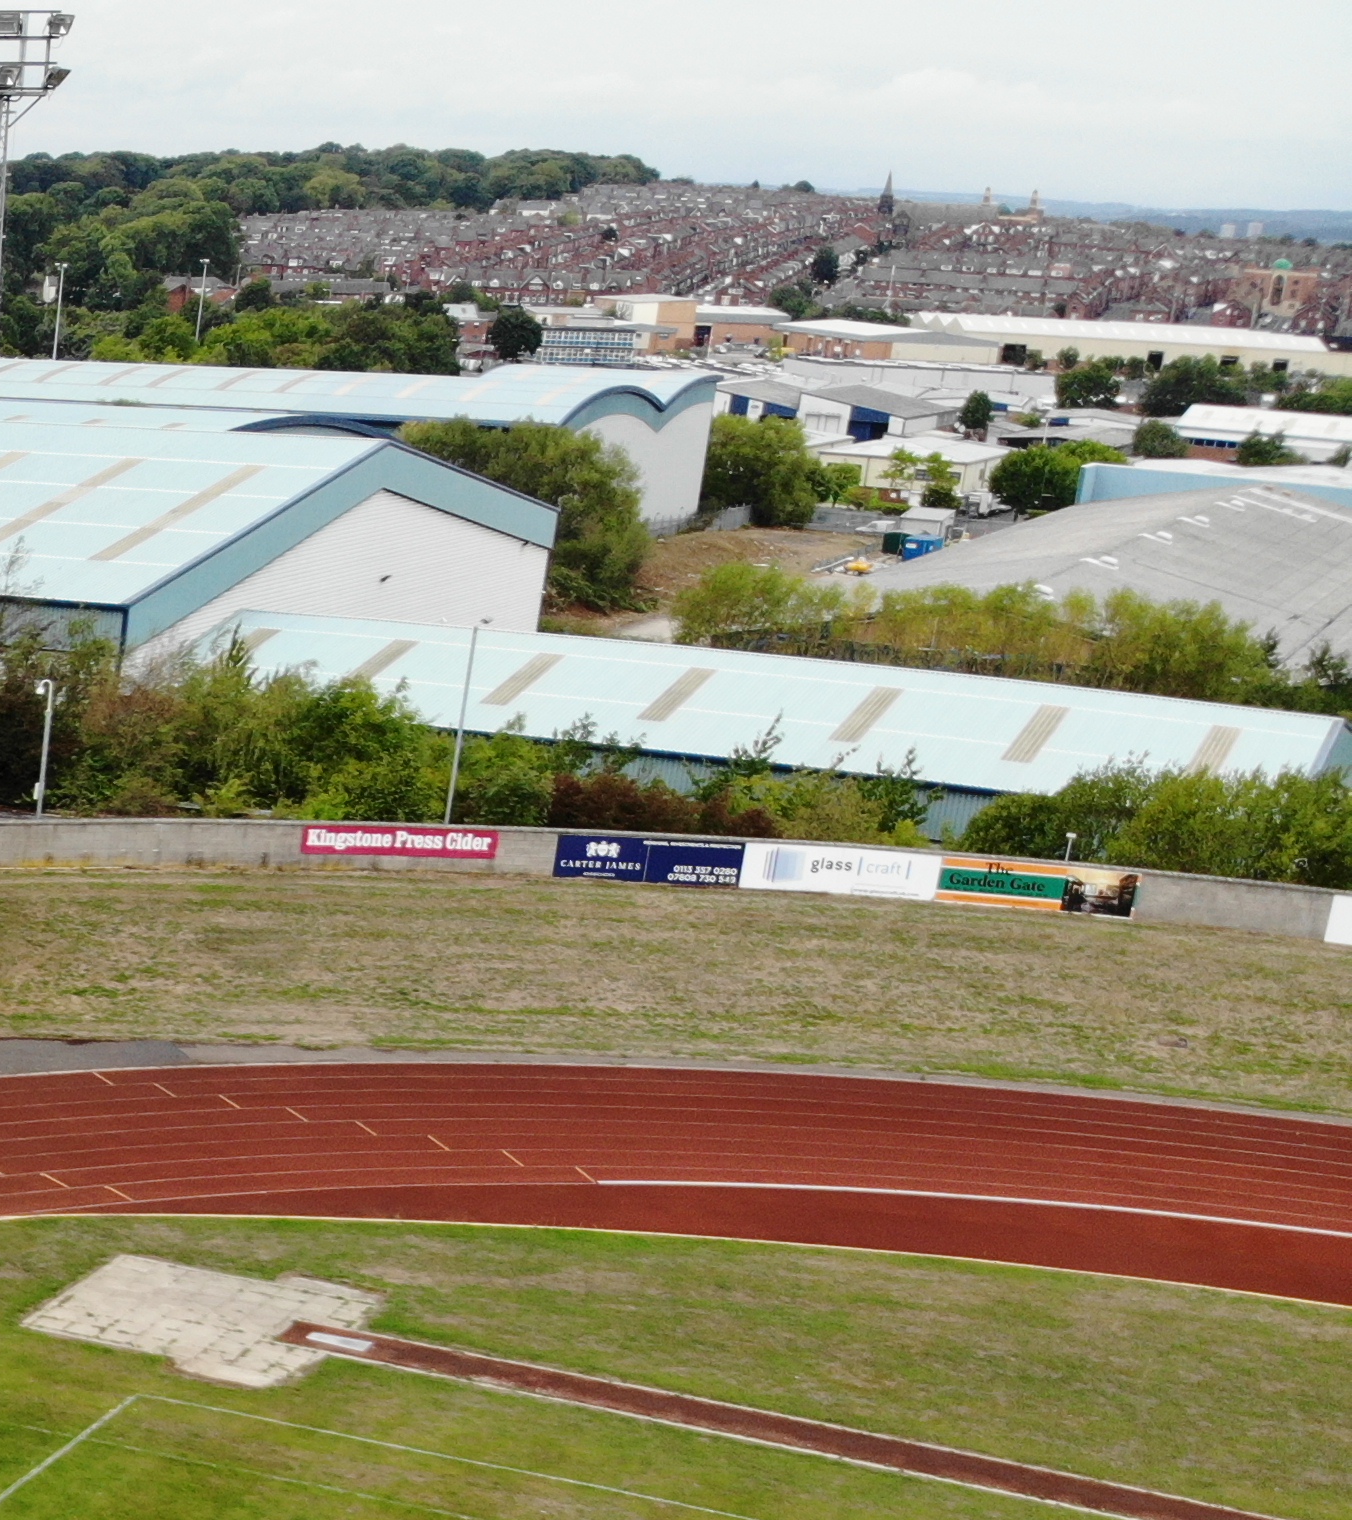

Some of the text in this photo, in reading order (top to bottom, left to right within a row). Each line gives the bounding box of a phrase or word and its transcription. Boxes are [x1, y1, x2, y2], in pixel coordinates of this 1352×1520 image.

[306, 829, 492, 851] Kingstone Press Cider
[560, 859, 642, 871] CARTER JAMES
[810, 857, 902, 875] glass craft
[985, 862, 1014, 876] The
[949, 873, 1005, 889] Garden
[1009, 877, 1046, 892] Gate
